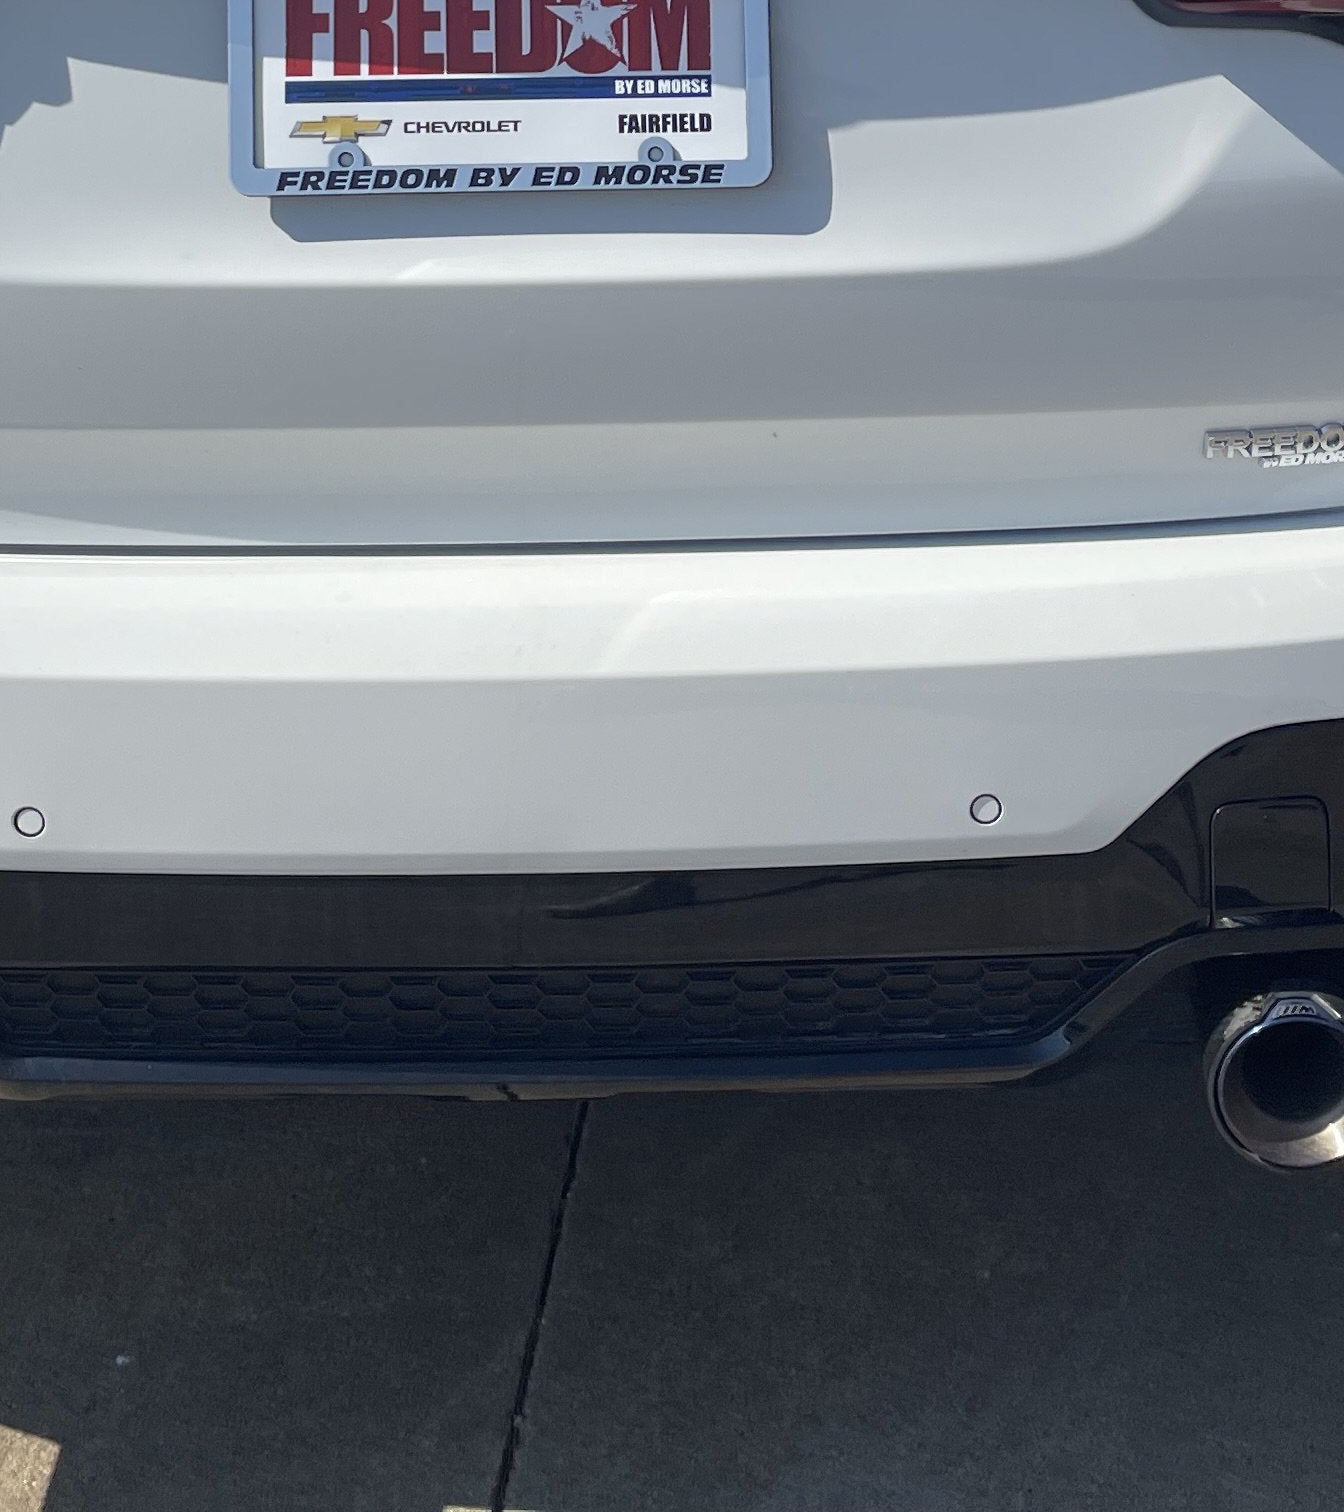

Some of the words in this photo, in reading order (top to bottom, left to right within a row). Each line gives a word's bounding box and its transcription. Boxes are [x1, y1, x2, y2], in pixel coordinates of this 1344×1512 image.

[614, 79, 634, 94] BY
[636, 79, 655, 94] ED
[657, 78, 709, 94] MORSE
[403, 119, 523, 134] CHEVROLET
[618, 113, 712, 134] FAIRFIELD
[276, 168, 458, 192] FREEDOM
[469, 166, 523, 188] BY
[531, 165, 580, 187] ED
[593, 162, 726, 186] MORSE
